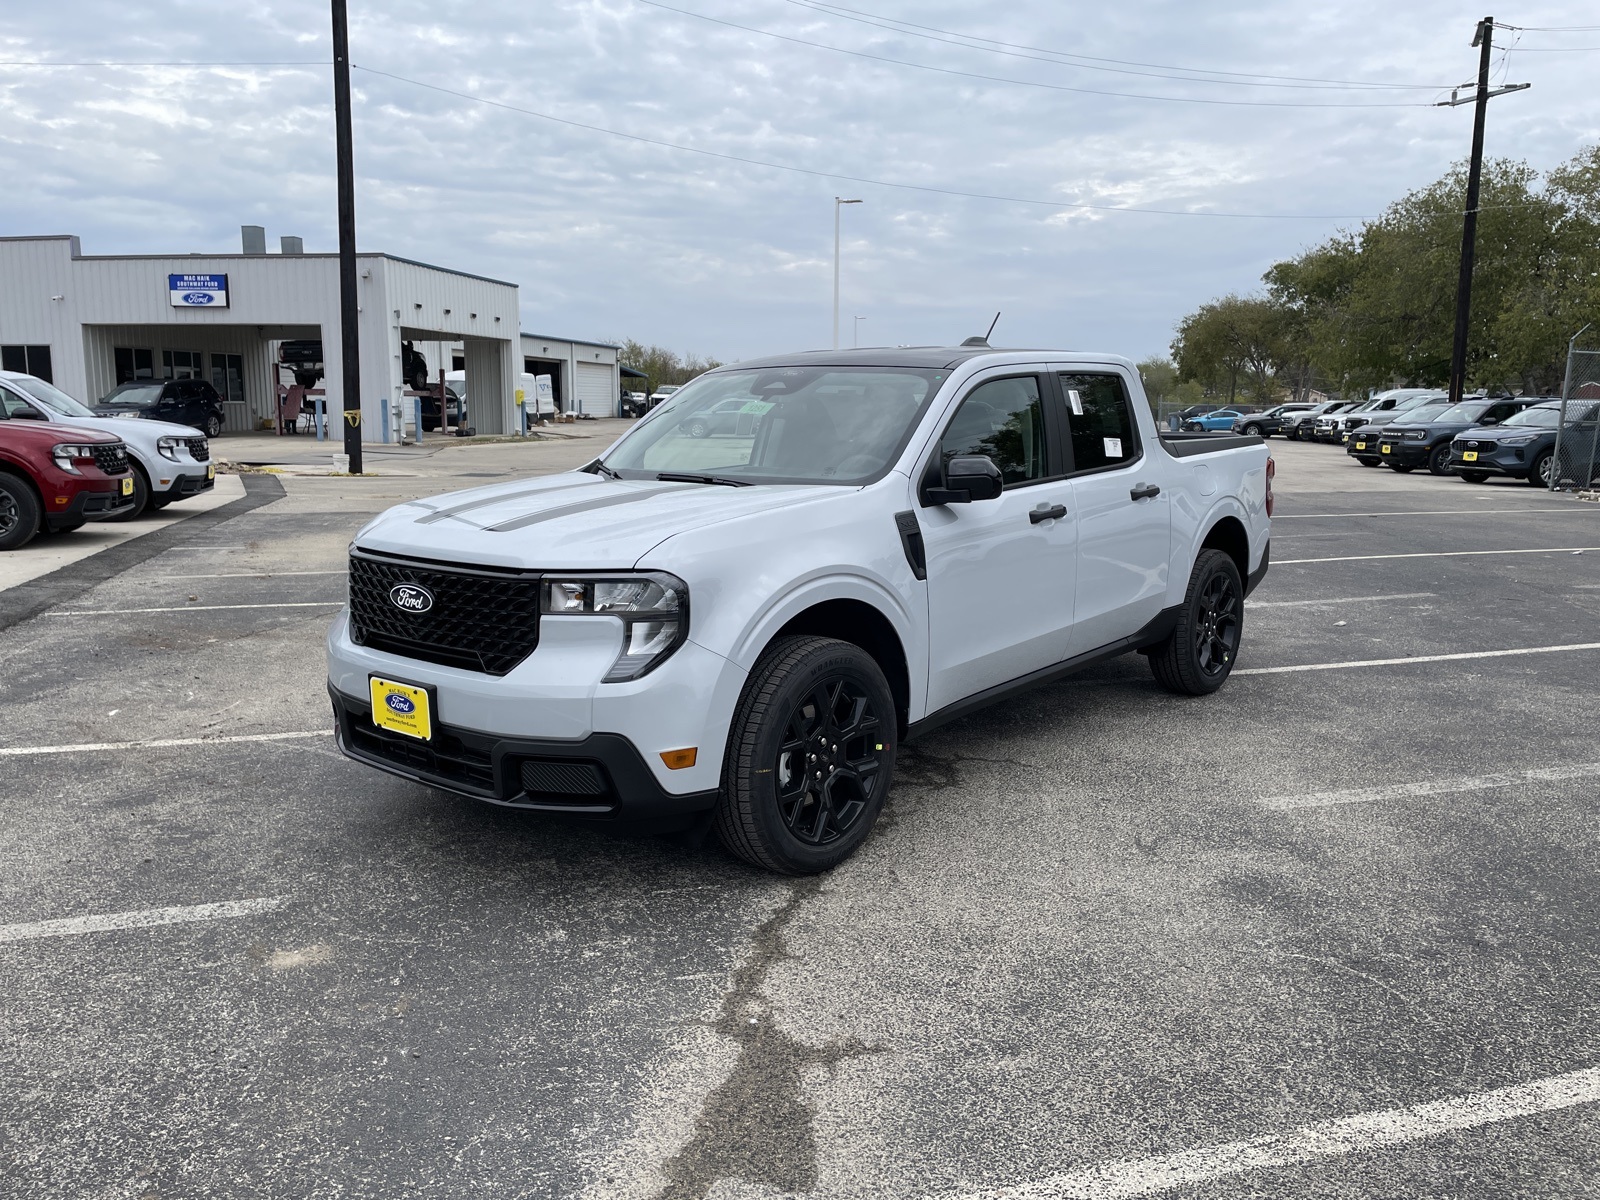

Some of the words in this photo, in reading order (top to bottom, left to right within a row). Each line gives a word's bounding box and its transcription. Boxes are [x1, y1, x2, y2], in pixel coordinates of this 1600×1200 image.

[188, 293, 209, 303] Ford
[397, 587, 424, 609] Ford
[811, 657, 854, 676] WRANGLER
[390, 695, 410, 711] Ford
